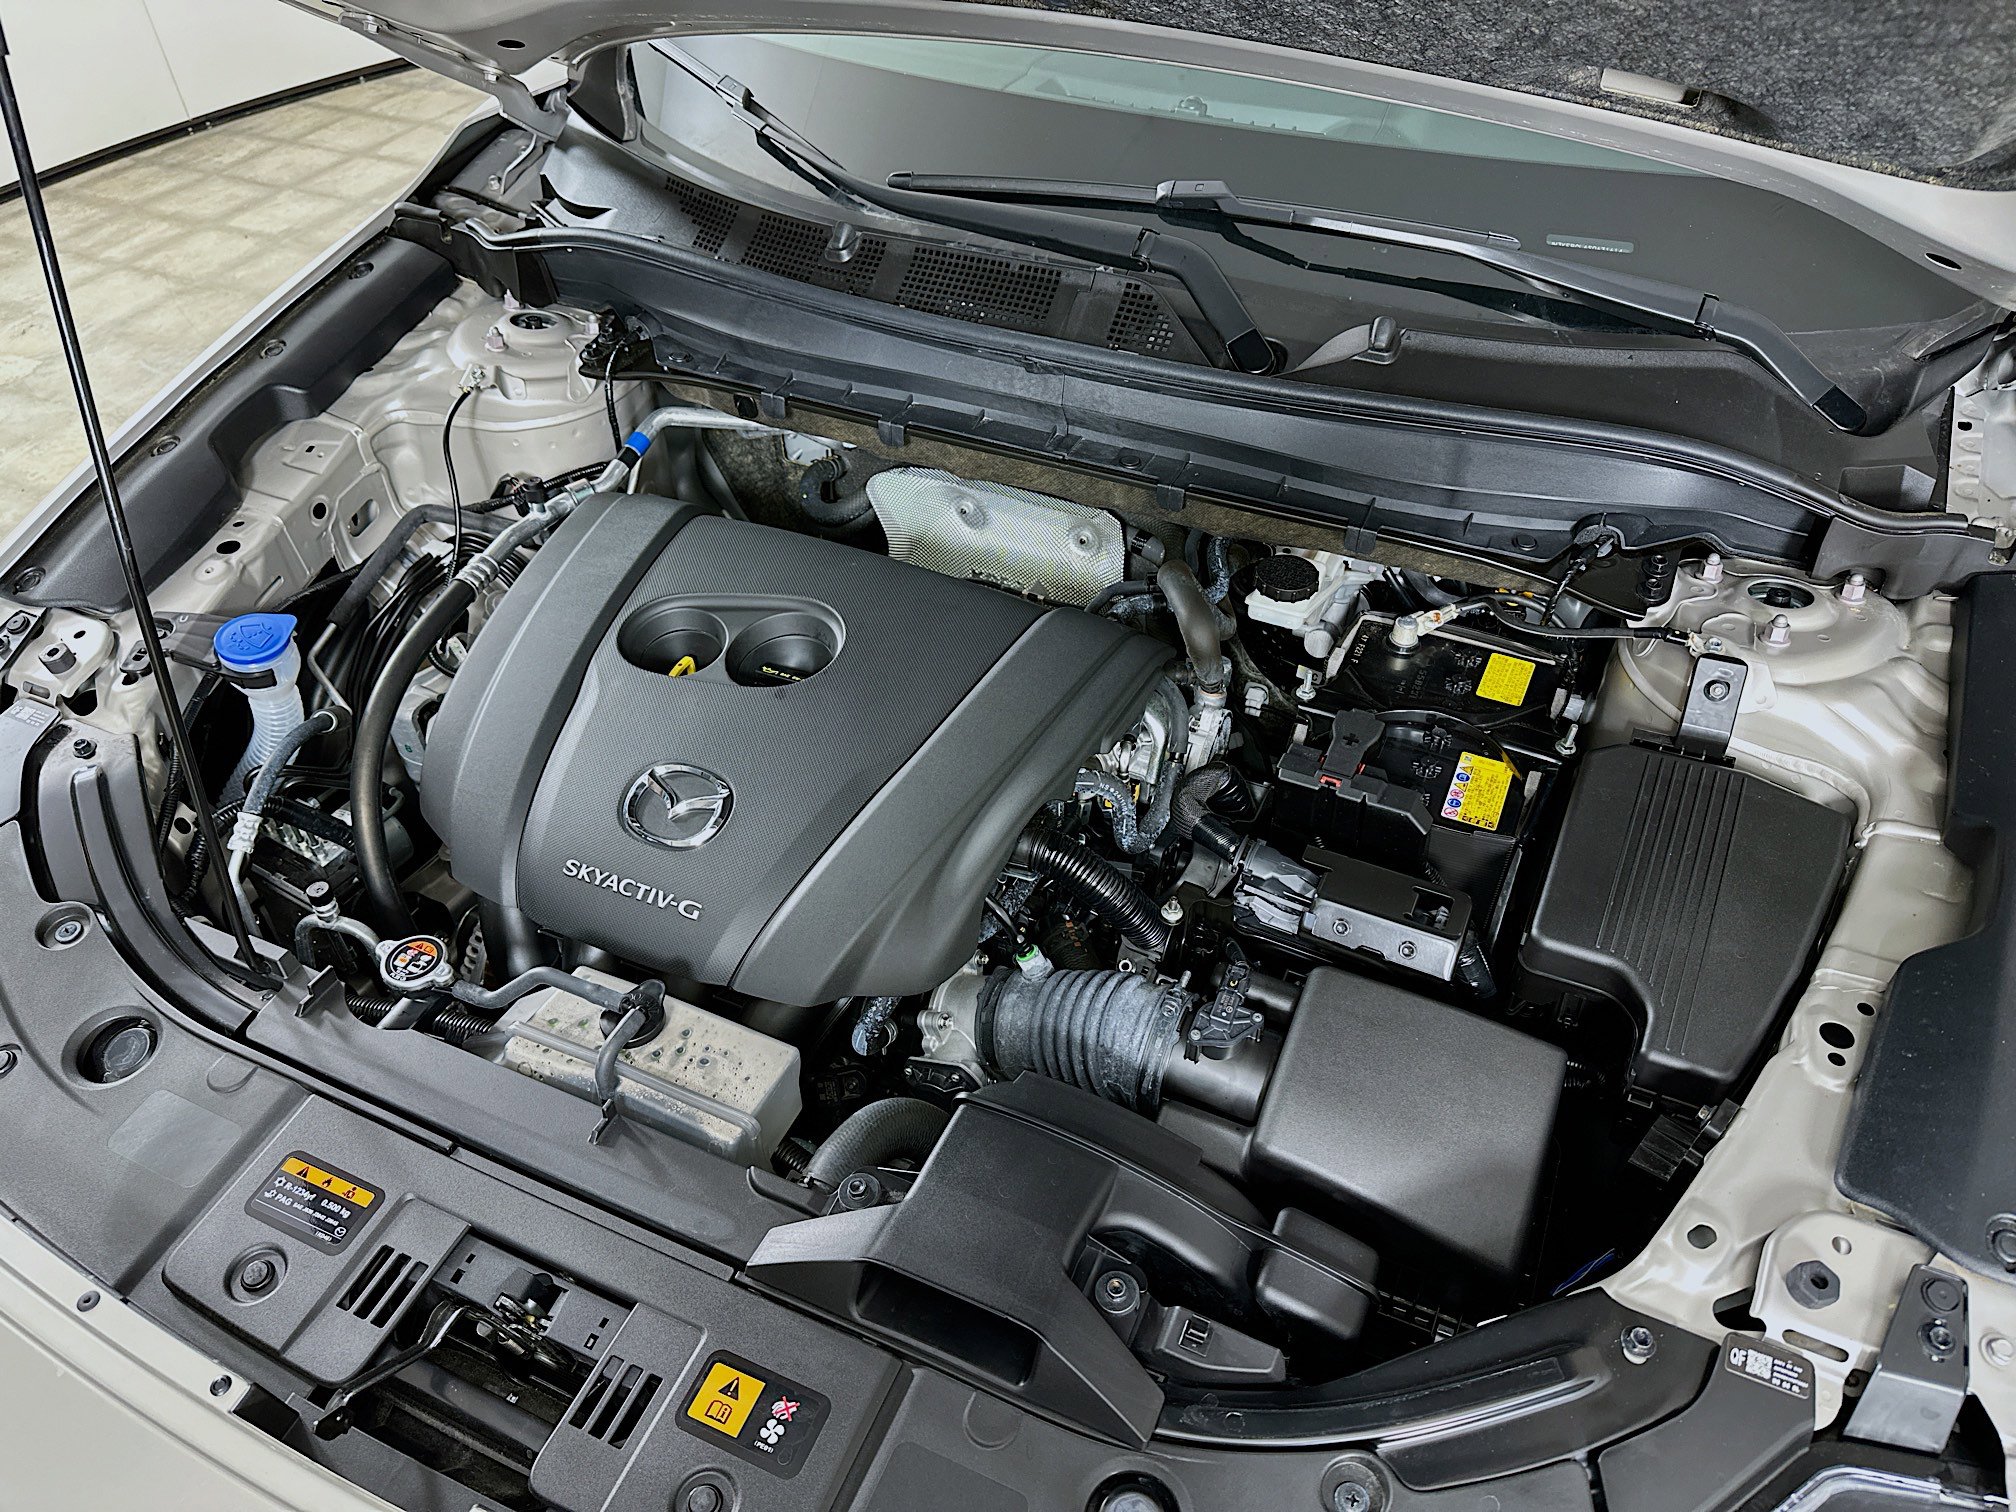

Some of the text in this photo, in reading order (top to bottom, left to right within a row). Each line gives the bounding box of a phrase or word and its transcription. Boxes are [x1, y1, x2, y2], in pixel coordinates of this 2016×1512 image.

[562, 859, 702, 921] SKYACTIV-G
[275, 1193, 293, 1206] PAG
[284, 1181, 352, 1219] R-1234yf 0.500 kg
